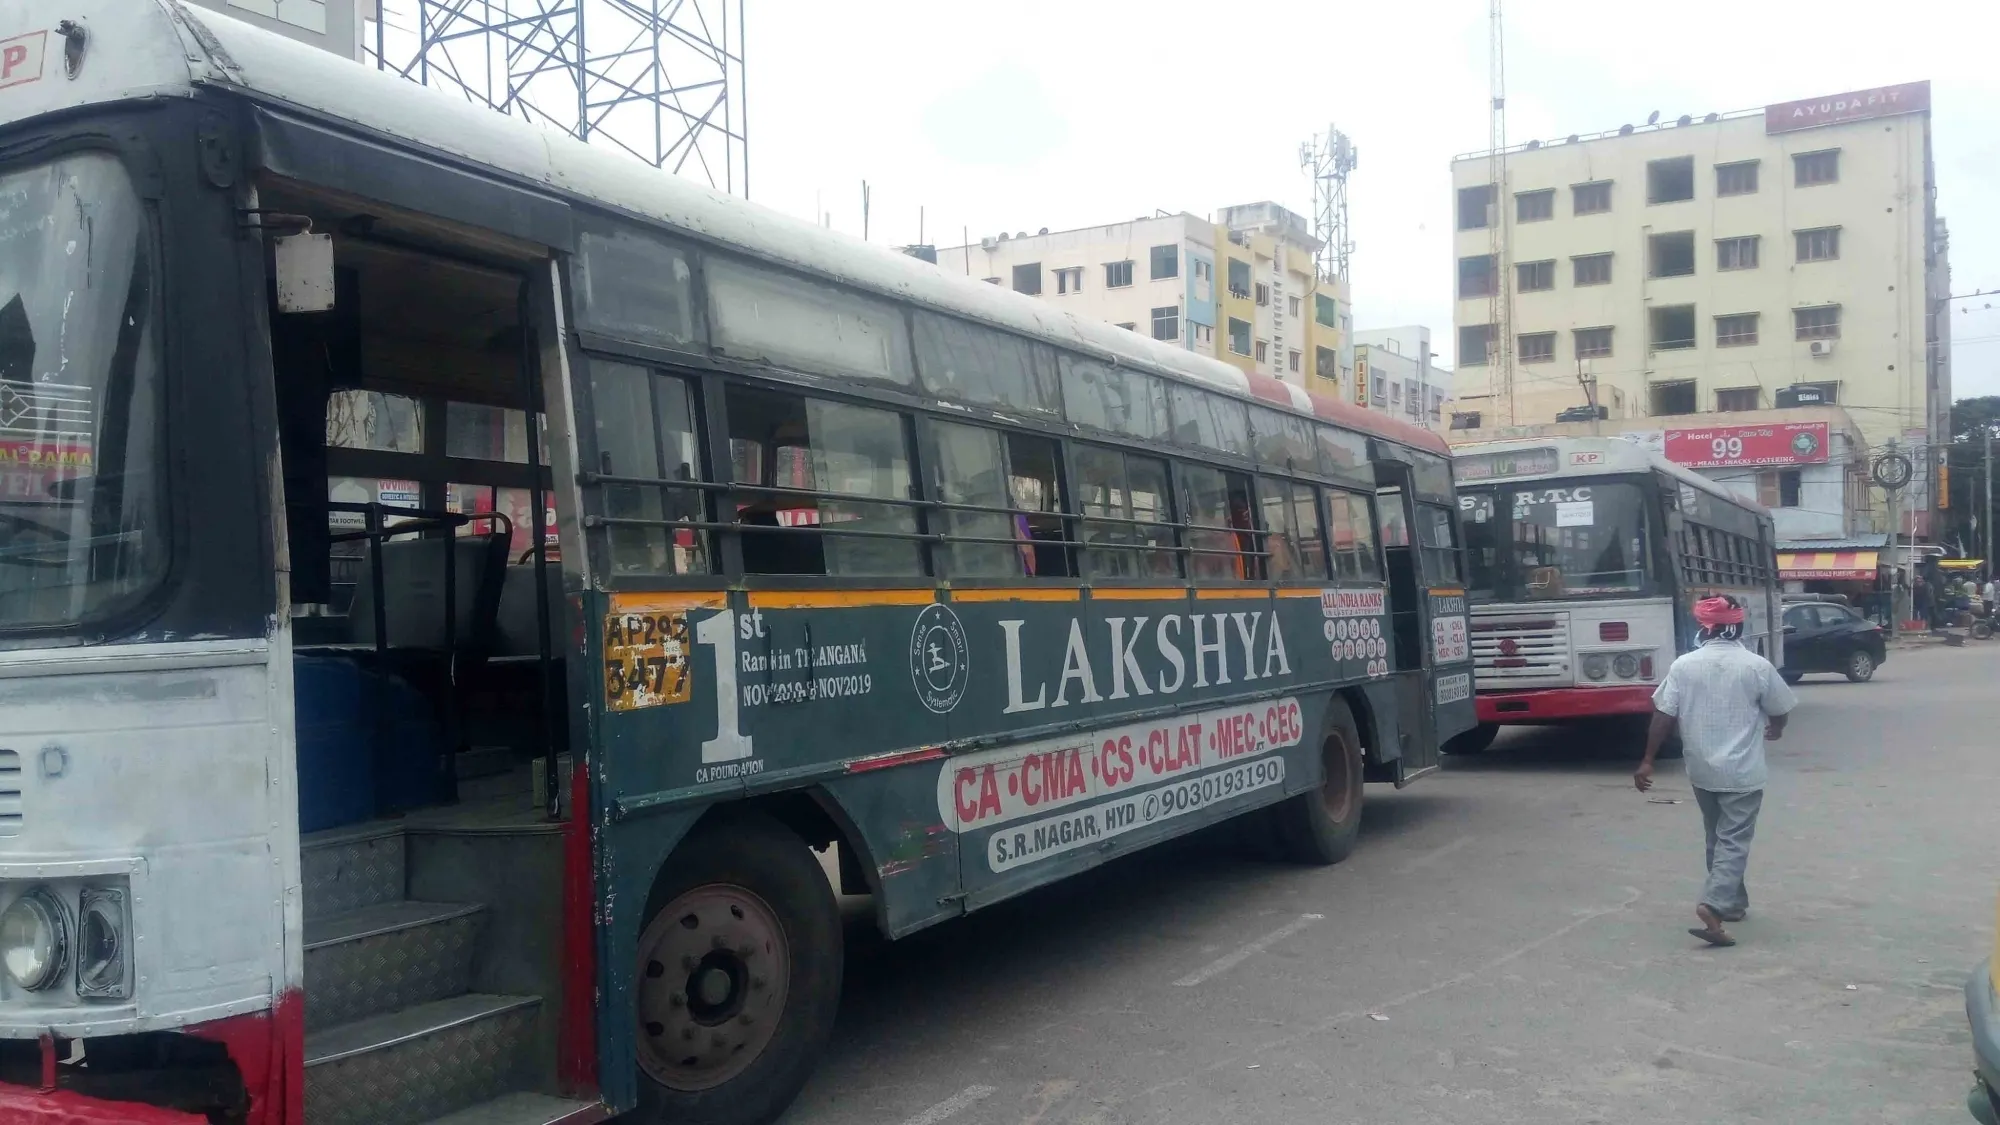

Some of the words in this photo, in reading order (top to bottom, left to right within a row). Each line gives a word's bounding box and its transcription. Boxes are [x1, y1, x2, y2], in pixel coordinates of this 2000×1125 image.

[1687, 432, 1713, 441] Hotel
[1711, 437, 1743, 459] 99
[1575, 453, 1599, 464] KP
[1756, 456, 1795, 464] CATERING
[1322, 592, 1337, 609] ALL
[1338, 592, 1360, 608] INDIA
[1360, 591, 1382, 608] RANKS
[1439, 597, 1465, 613] LAKSHYA
[913, 624, 927, 656] Sense
[950, 621, 964, 653] Smart
[998, 610, 1292, 714] LAKSHYA
[955, 767, 1003, 823] CA
[1021, 747, 1086, 806] CMA
[1101, 735, 1134, 787] CS
[1150, 723, 1202, 775] CLAT
[1216, 712, 1256, 759] MEC
[1266, 702, 1300, 745] CEC
[696, 768, 709, 783] CA
[1105, 803, 1136, 831] HYD
[1162, 760, 1278, 816] 9030193190
